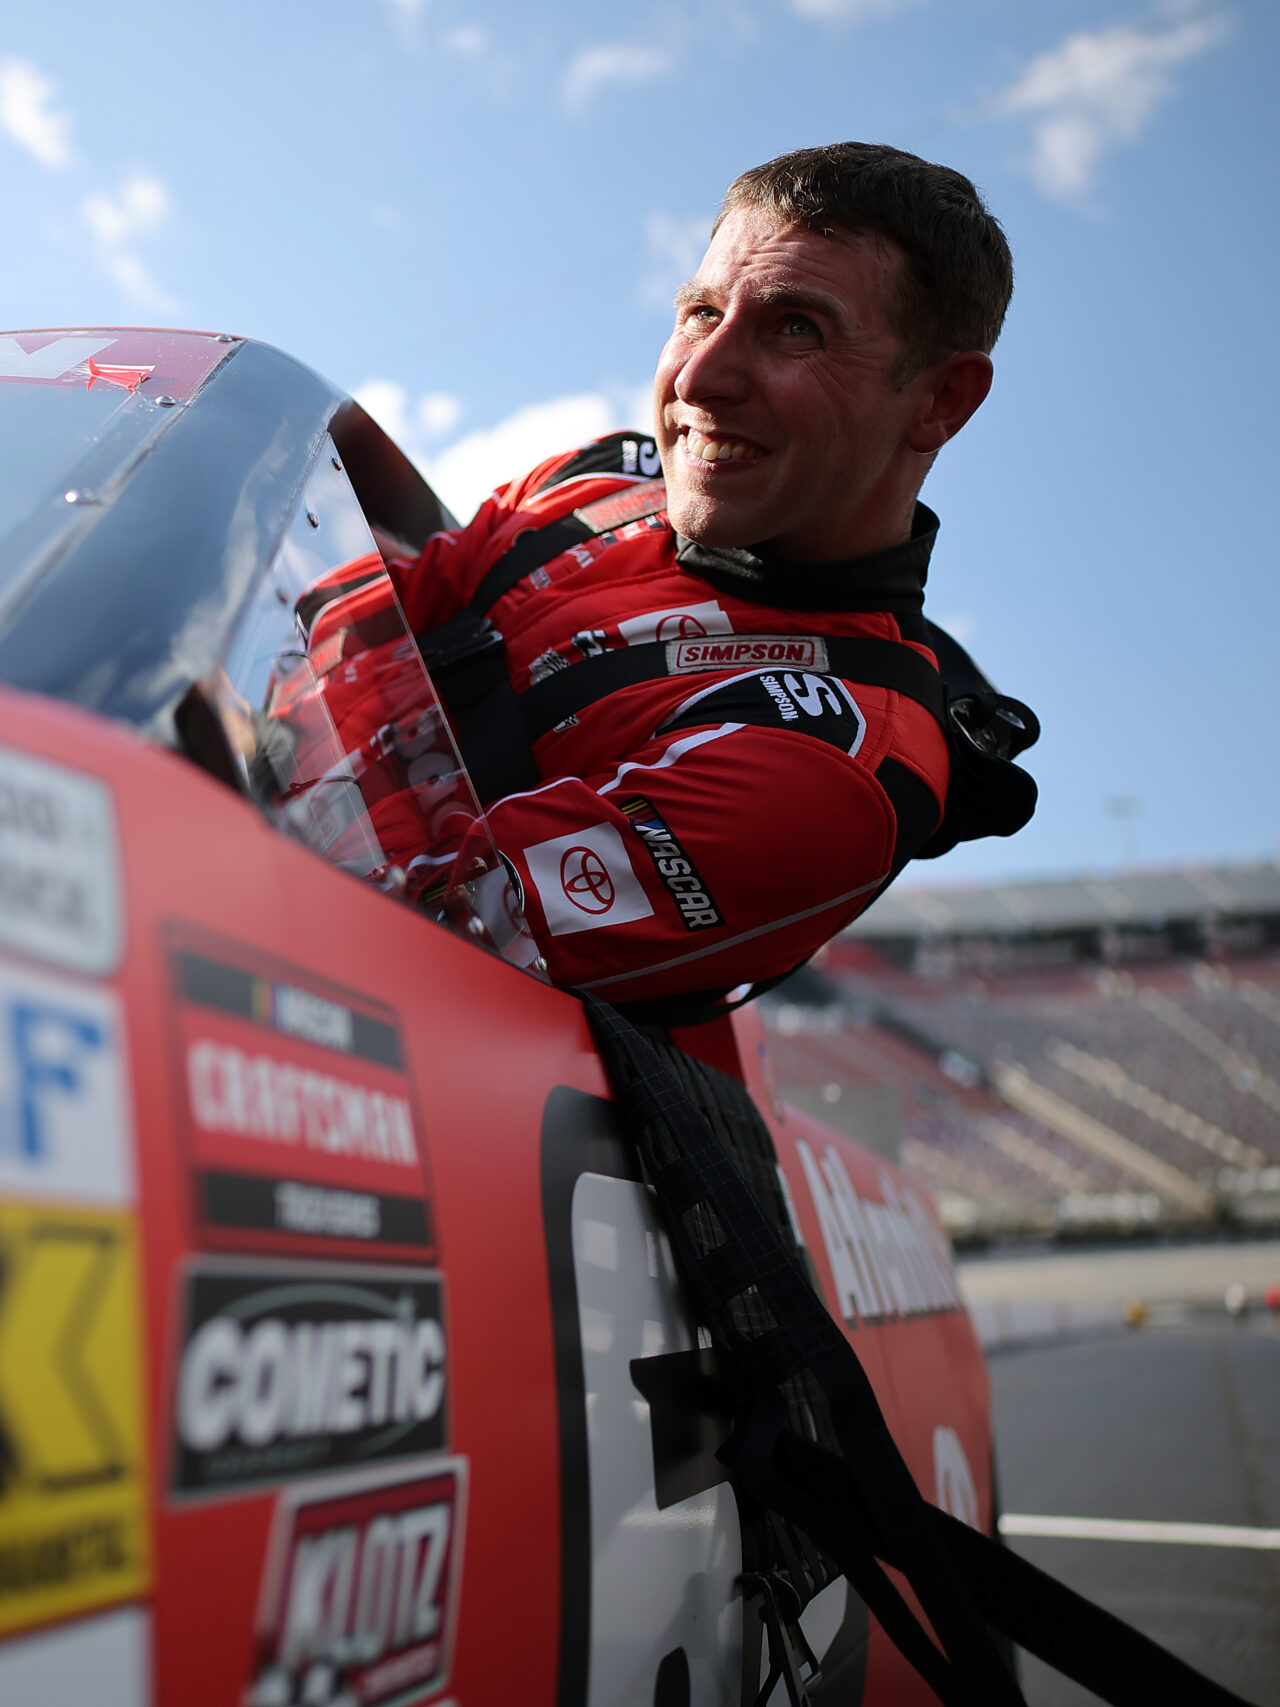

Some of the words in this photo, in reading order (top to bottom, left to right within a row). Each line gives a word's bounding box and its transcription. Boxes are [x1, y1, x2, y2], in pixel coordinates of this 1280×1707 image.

[683, 643, 806, 663] SIMPSON
[759, 674, 800, 722] SIMPSON
[782, 672, 843, 717] S
[634, 824, 719, 928] NASCAR
[187, 1037, 420, 1168] CRAFTSMAN
[176, 1312, 448, 1452] COMETIC
[280, 1503, 451, 1674] KLOTZ
